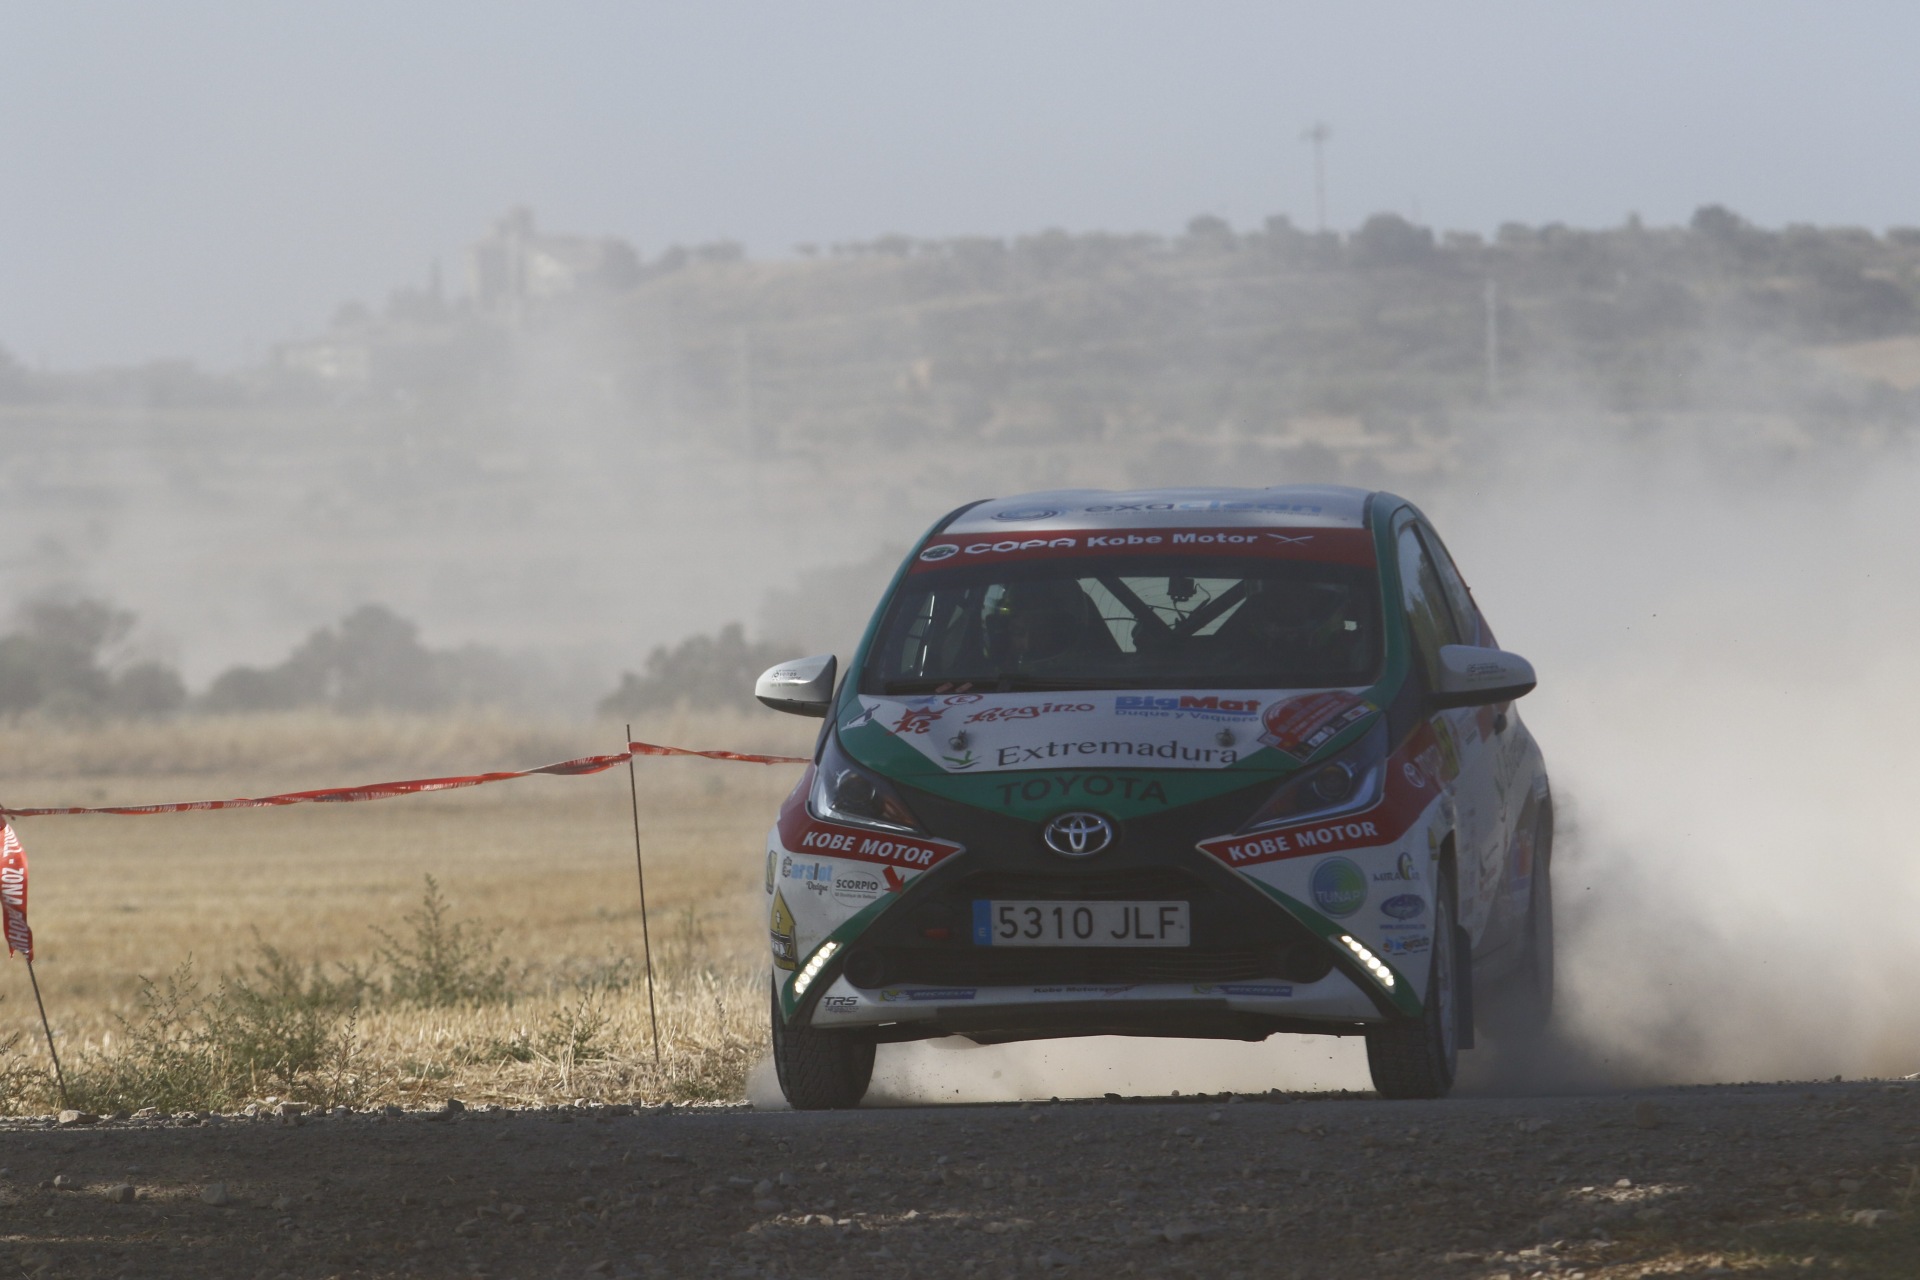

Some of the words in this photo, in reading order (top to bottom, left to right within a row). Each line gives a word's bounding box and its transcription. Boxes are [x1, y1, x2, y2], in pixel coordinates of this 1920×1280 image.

[964, 537, 1076, 554] COPA
[1086, 534, 1162, 547] Kobe
[1172, 532, 1258, 544] Motor
[1115, 695, 1261, 711] BigMat
[1115, 710, 1169, 718] Duque
[1190, 712, 1259, 722] Vaquero
[998, 741, 1238, 766] Extremadura
[996, 774, 1168, 806] TOYOTA
[802, 831, 856, 851] KOBE
[859, 838, 934, 866] MOTOR
[1228, 835, 1291, 861] KOBE
[1295, 821, 1378, 847] MOTOR
[1, 867, 24, 905] ZONA
[835, 878, 879, 890] SCORPIO
[1316, 889, 1362, 903] TUNAP
[978, 926, 987, 938] E
[999, 906, 1093, 939] 5310
[1110, 906, 1178, 939] JLF
[824, 996, 859, 1006] TRS
[913, 990, 974, 998] MICHELIN
